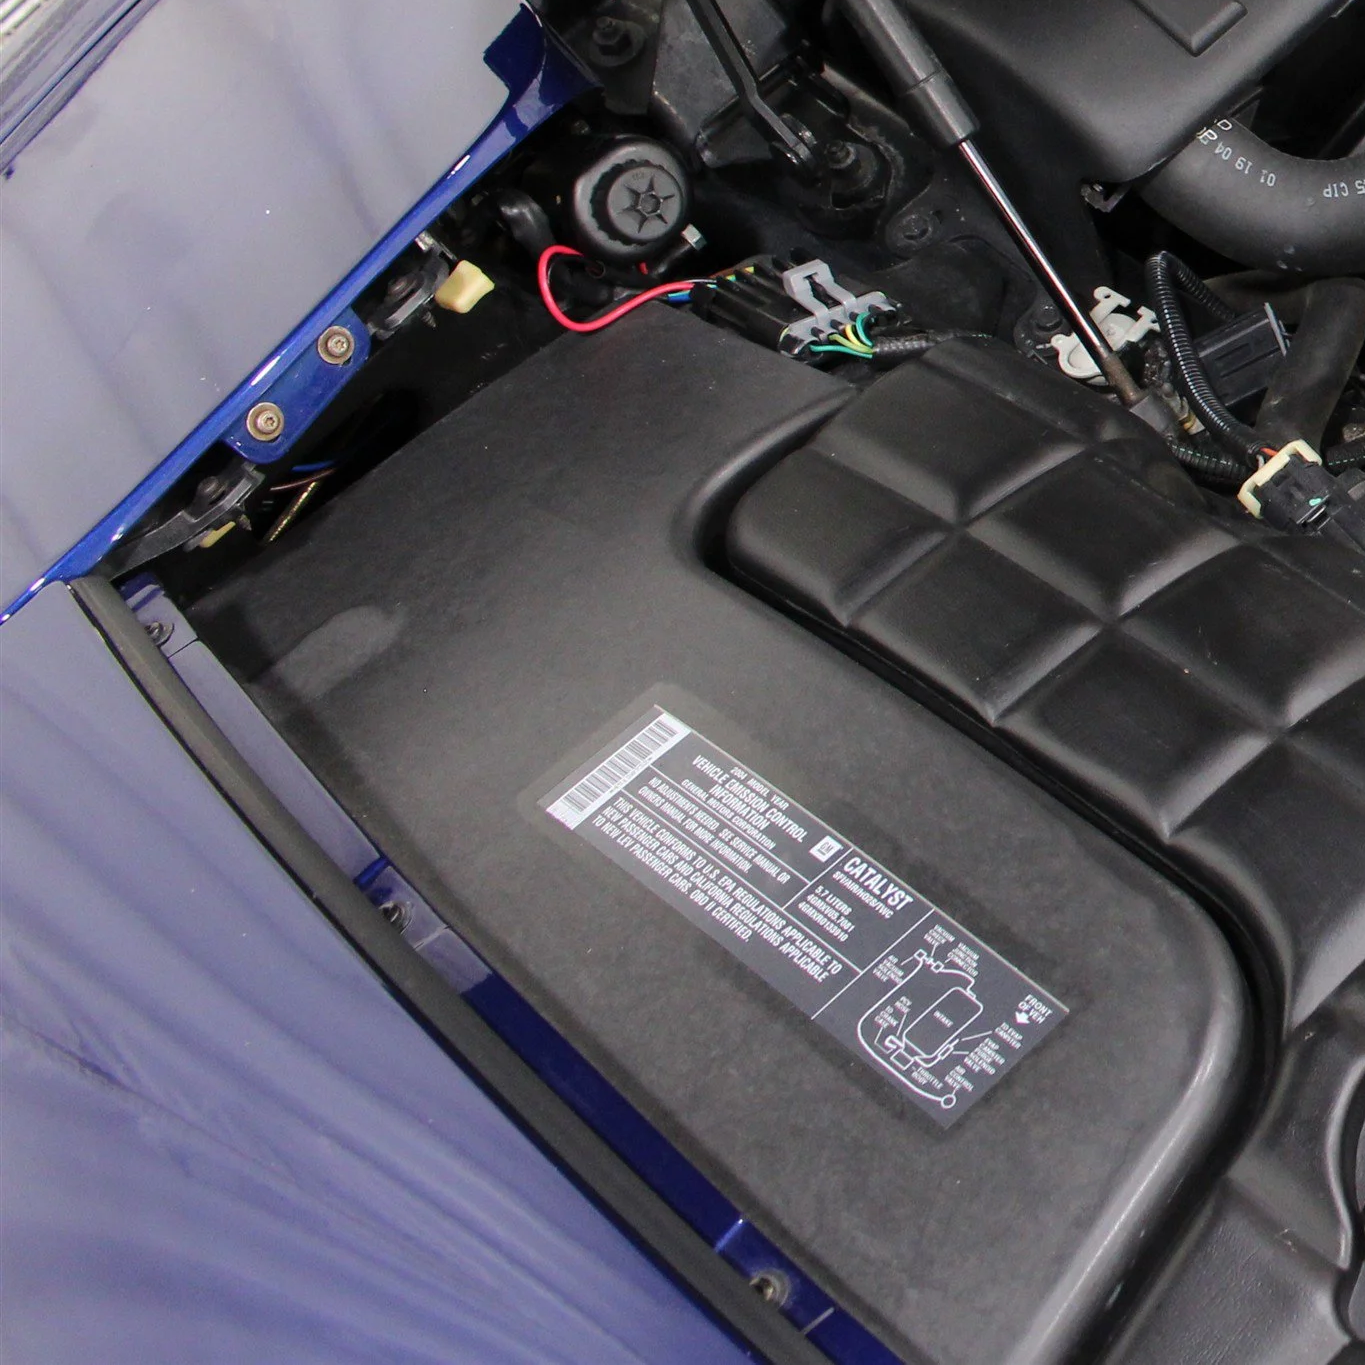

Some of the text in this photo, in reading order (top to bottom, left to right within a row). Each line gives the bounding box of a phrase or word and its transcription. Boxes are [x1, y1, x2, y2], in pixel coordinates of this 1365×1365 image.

[1214, 141, 1277, 187] 01 19 04
[680, 778, 775, 849] GENERAL MOTORS CORPORATION
[691, 755, 729, 784] VEHICLE
[724, 778, 769, 812] EMISSION
[764, 807, 809, 842] CONTROL
[708, 783, 769, 830] INFORMATION
[746, 778, 770, 797] MODEL
[770, 795, 789, 810] YEAR
[637, 785, 753, 873] OWNERS MANUAL FOR MORE INFORMATION.
[648, 776, 790, 883] NO ADJUSTMENTS NEEDED. SEE SERVICE MANUAL OR
[591, 814, 755, 942] TO NEW LEV PASSENGER CARS. OBD II CERTIFIED.
[602, 805, 829, 982] NEW PASSENGER CARS AND CALIFORNIA REGULATIONS APPLICABLE
[612, 796, 843, 975] THIS VEHICLE CONFORMS TO U.S. EPA REGULATIONS APPLICABLE TO
[814, 885, 852, 915] 5.7 LITERS
[841, 856, 913, 911] CATALYST
[1016, 1001, 1045, 1023] OF VEH
[1023, 994, 1052, 1017] FRONT
